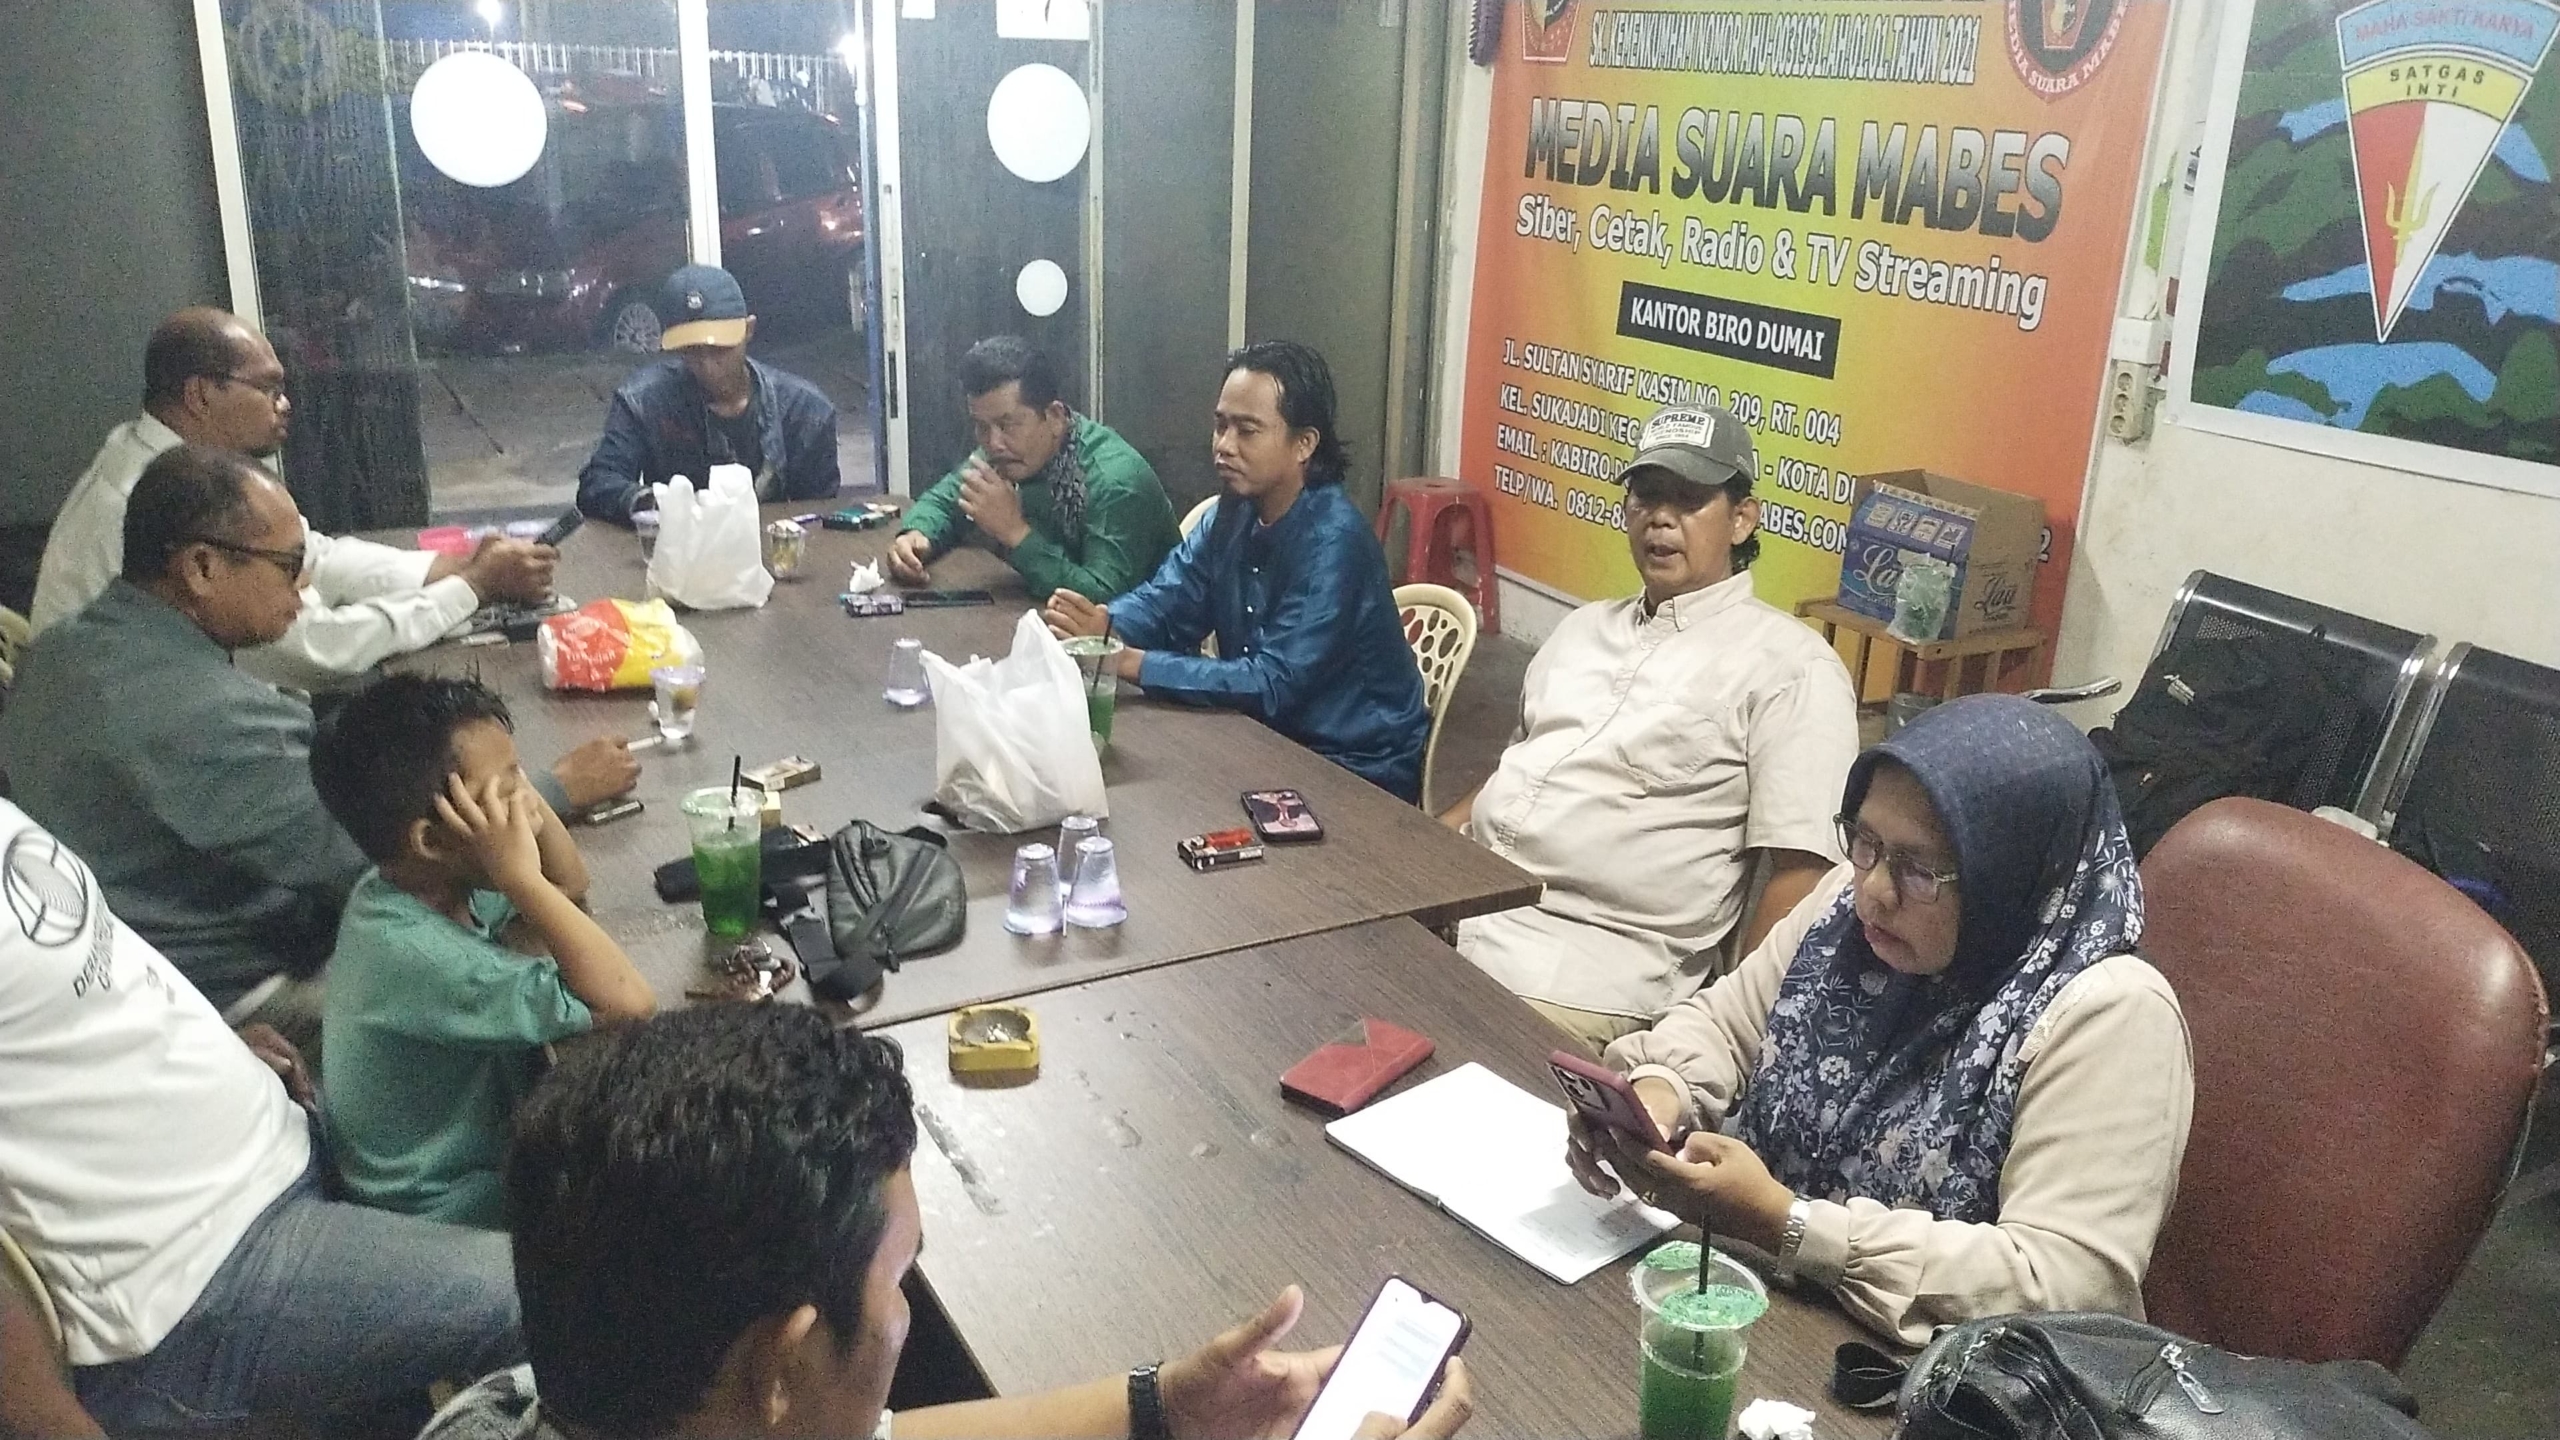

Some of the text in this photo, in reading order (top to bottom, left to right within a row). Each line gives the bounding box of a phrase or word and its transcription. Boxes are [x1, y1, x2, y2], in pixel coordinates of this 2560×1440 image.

[1695, 11, 1743, 74] NOMOR
[1939, 14, 1981, 85] 2021
[2389, 65, 2485, 85] SATGAS
[2028, 70, 2080, 93] SUARA
[2406, 84, 2459, 98] INTI
[1524, 96, 2070, 243] MEDIA SUARA MABES
[1515, 193, 2048, 332] Siber, Cetak, Radio & TV Streaming
[1630, 297, 1825, 361] KANTOR BIRO DUMAI
[1503, 338, 1520, 366] JL.
[1523, 343, 1581, 381] SULTAN
[1581, 357, 1635, 395] SYARIF
[1636, 369, 1692, 404] KASIM
[1770, 400, 1799, 437] RT.
[1804, 408, 1841, 446] 004
[1496, 422, 1538, 460] EMAIL
[1499, 382, 1527, 416] KEL.
[1531, 391, 1606, 438] SUKAJADI
[1777, 456, 1829, 500] KOTA
[1651, 413, 1706, 429] SUPREME
[1494, 463, 1558, 511] TELP/WA.
